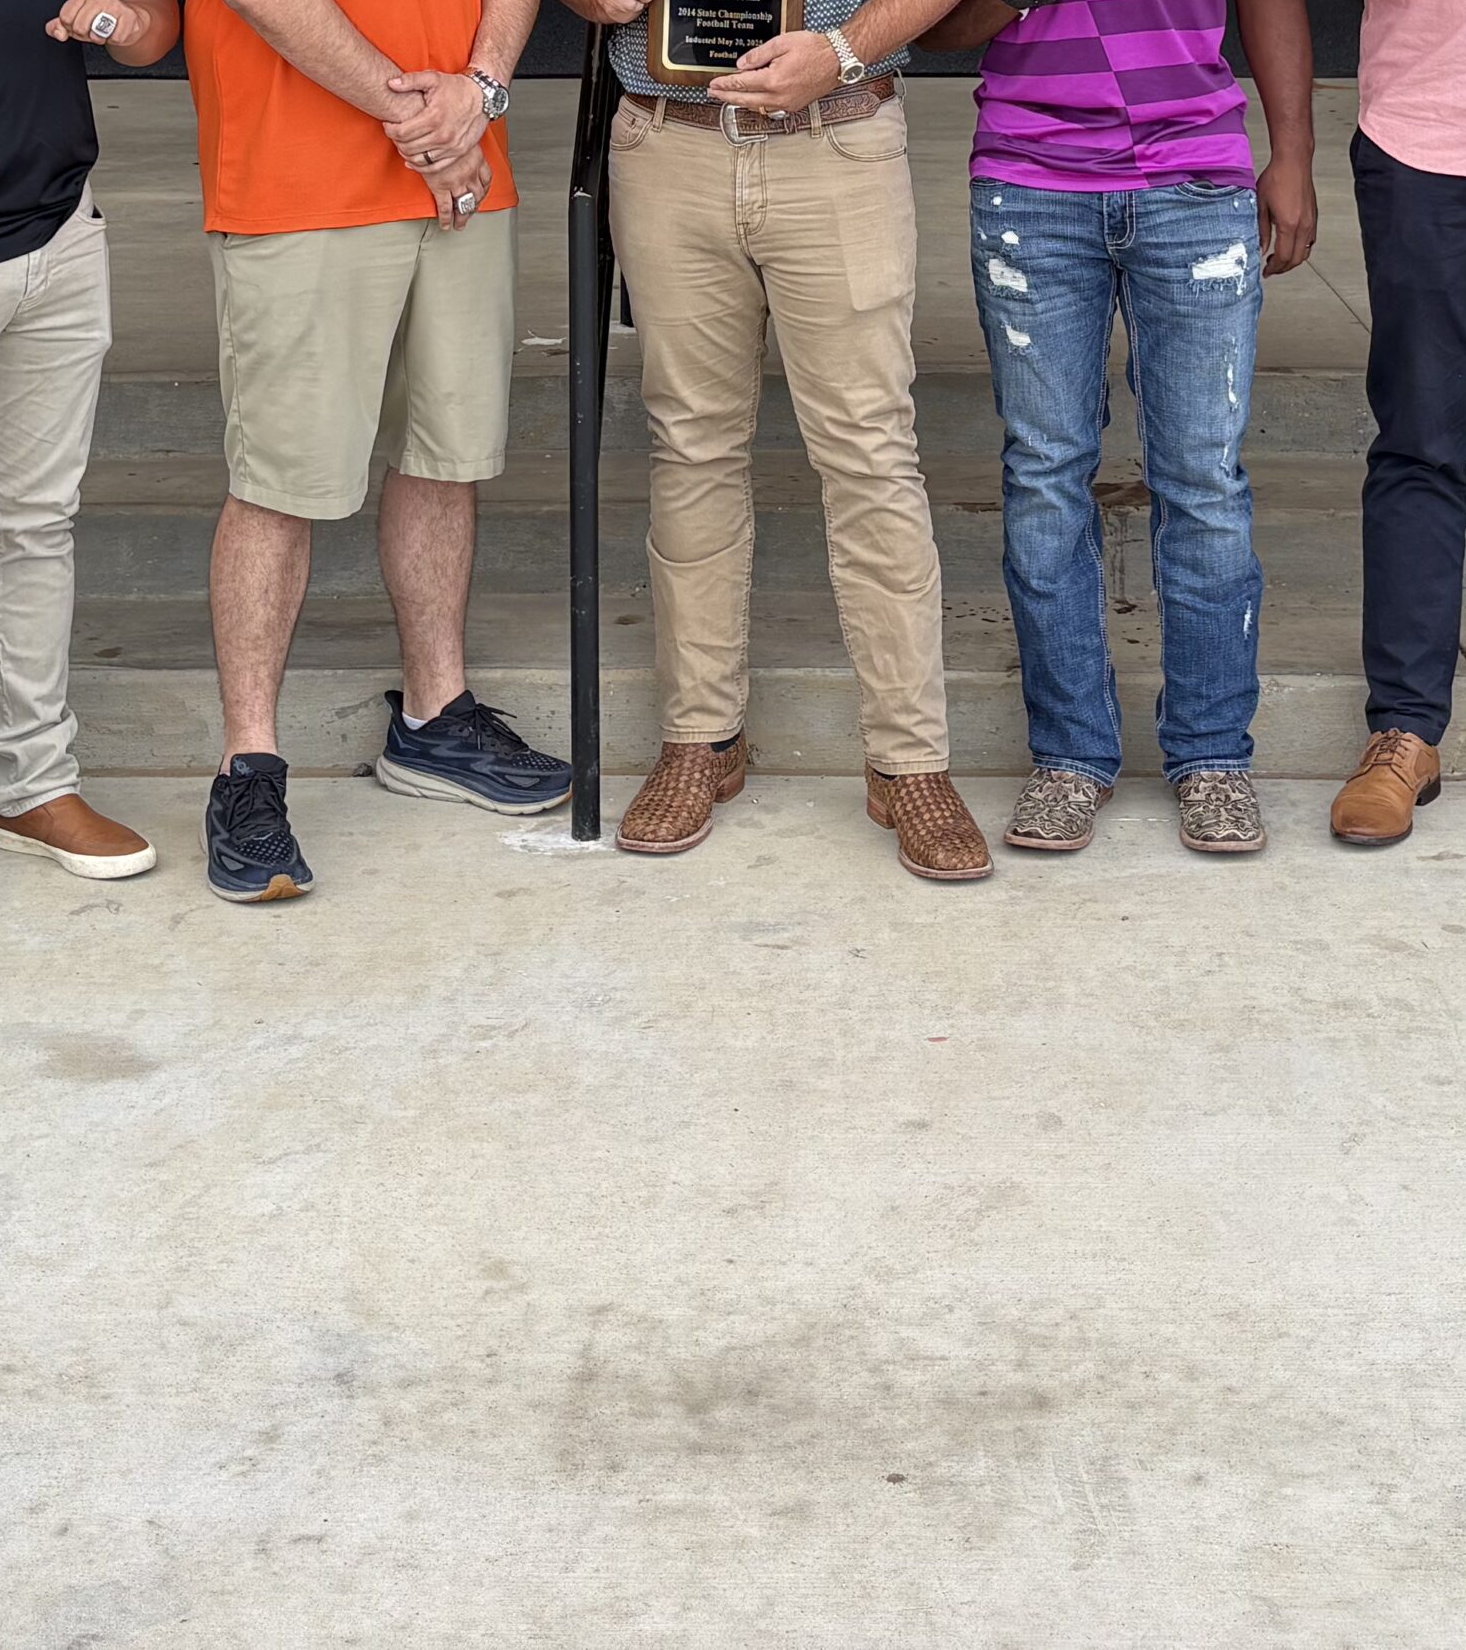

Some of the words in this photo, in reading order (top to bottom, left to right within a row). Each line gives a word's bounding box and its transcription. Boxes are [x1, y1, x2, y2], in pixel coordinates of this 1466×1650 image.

[678, 7, 696, 17] 2014
[696, 9, 716, 18] State
[718, 9, 773, 23] Championship
[696, 18, 730, 28] Football
[731, 21, 754, 30] Team
[685, 35, 716, 45] Inducted
[717, 37, 733, 47] May
[709, 50, 738, 59] Football
